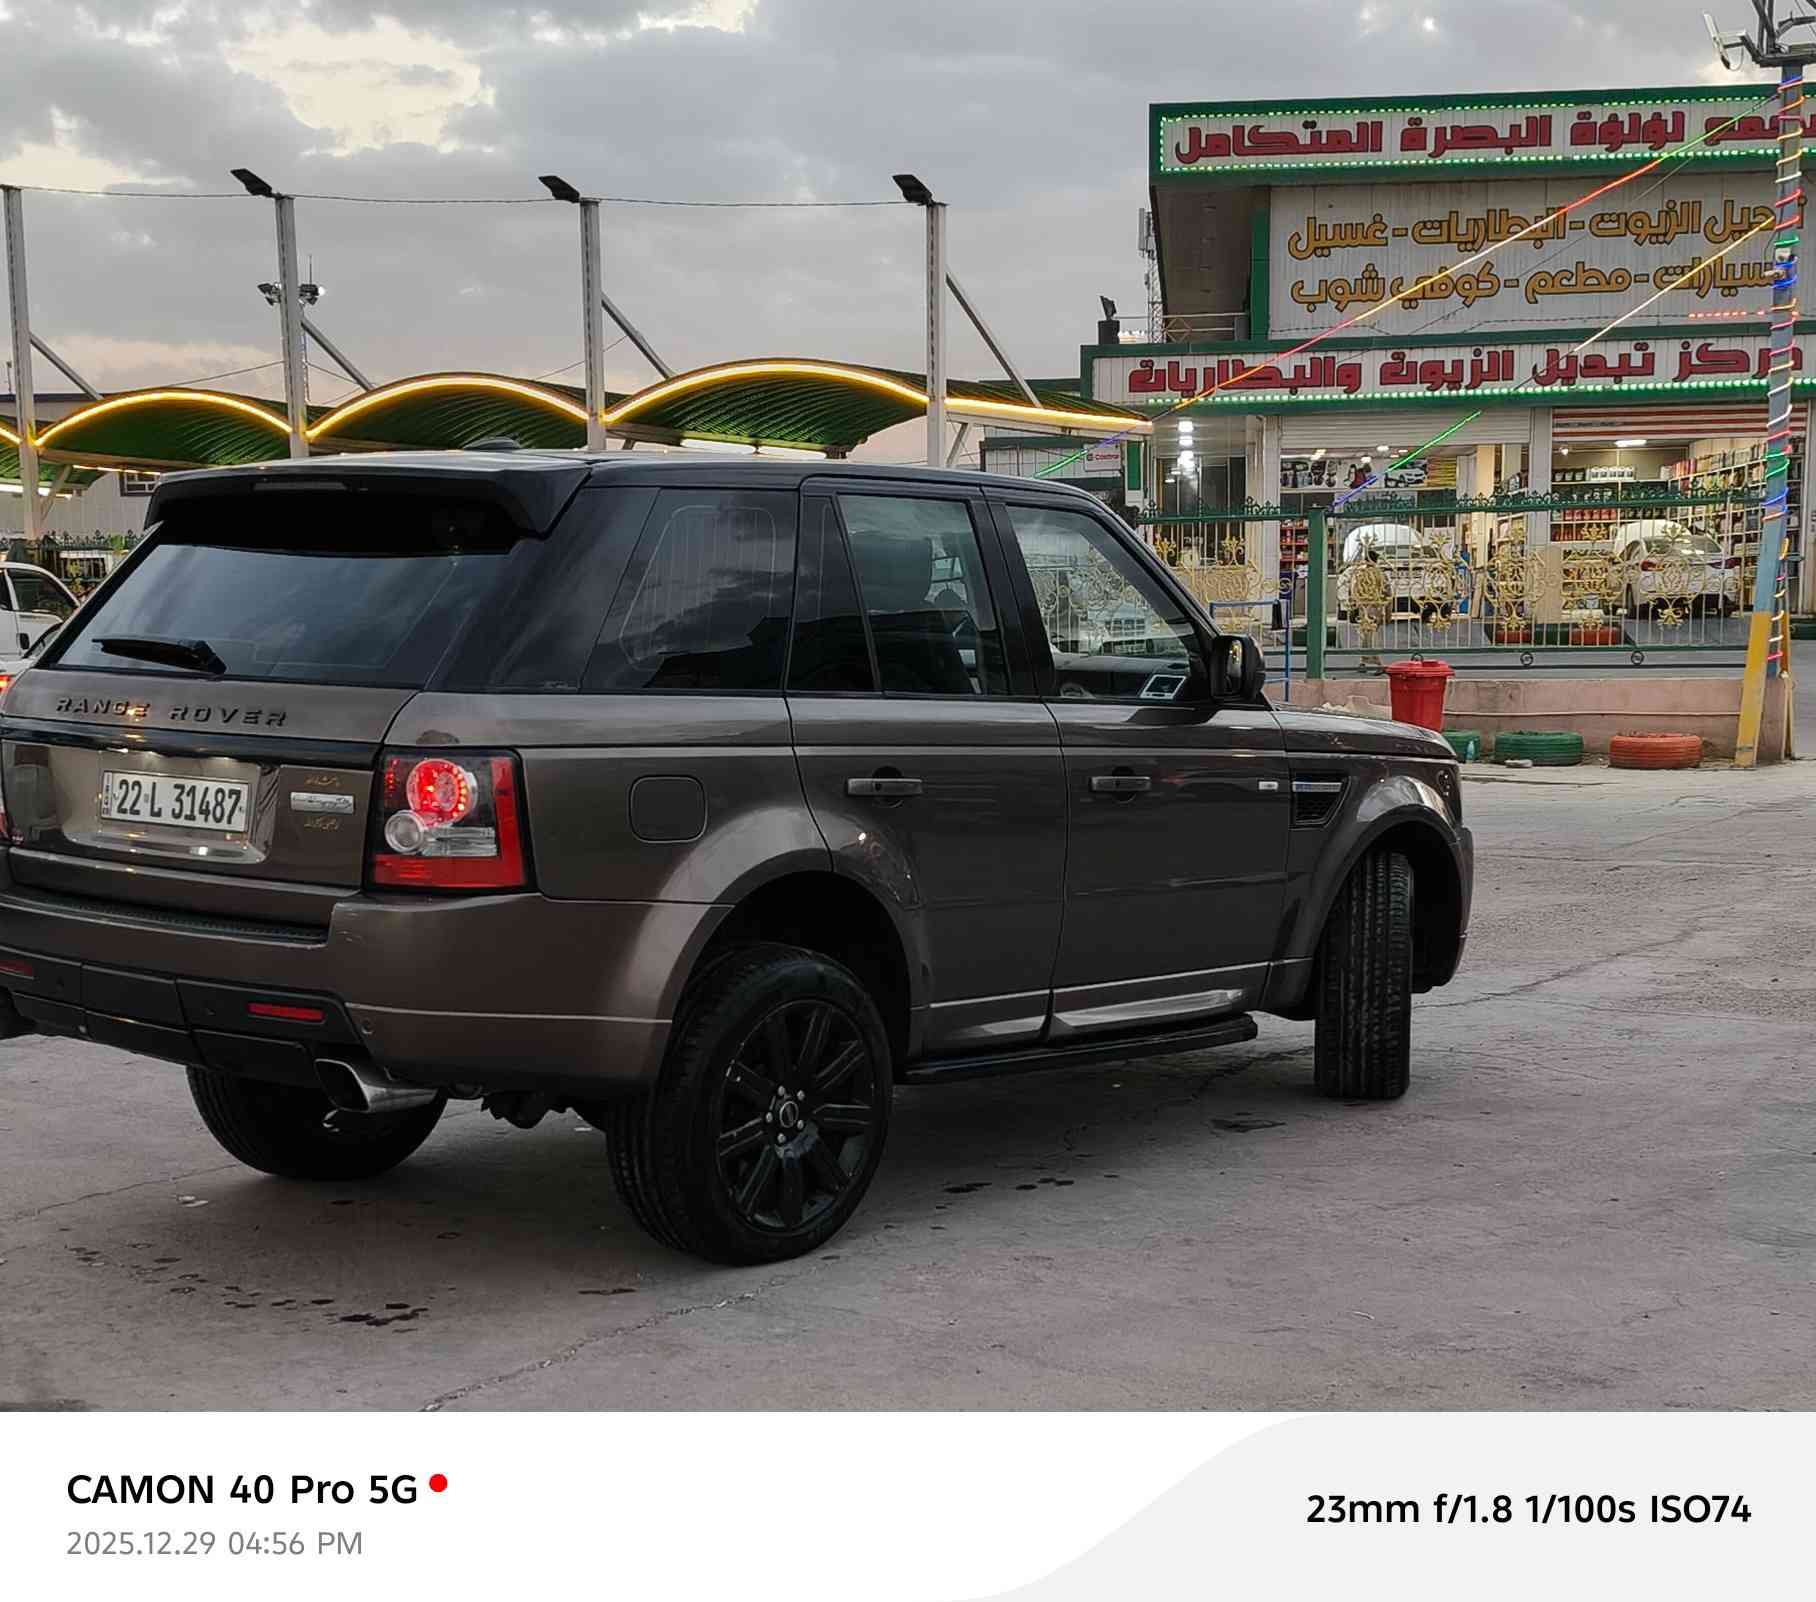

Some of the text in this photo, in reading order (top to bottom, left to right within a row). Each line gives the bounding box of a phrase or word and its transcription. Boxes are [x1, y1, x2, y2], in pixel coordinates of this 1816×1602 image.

[1175, 119, 1383, 164] المتكامل
[1400, 115, 1552, 158] البصرة
[1570, 111, 1685, 152] لؤلؤة
[1288, 213, 1389, 260] غسيل
[1411, 206, 1566, 252] البطاريات
[1589, 200, 1701, 246] الزيوت
[1291, 263, 1385, 312] شوب
[1390, 260, 1500, 309] كوفي
[1525, 261, 1632, 304] مطعم
[1128, 356, 1361, 398] والبطاريات
[1379, 348, 1514, 391] الزيوت
[1532, 342, 1655, 386] تبديل
[56, 697, 287, 727] RANGE ROVER
[117, 779, 142, 815] 22
[150, 782, 162, 817] L
[171, 783, 242, 824] 31487
